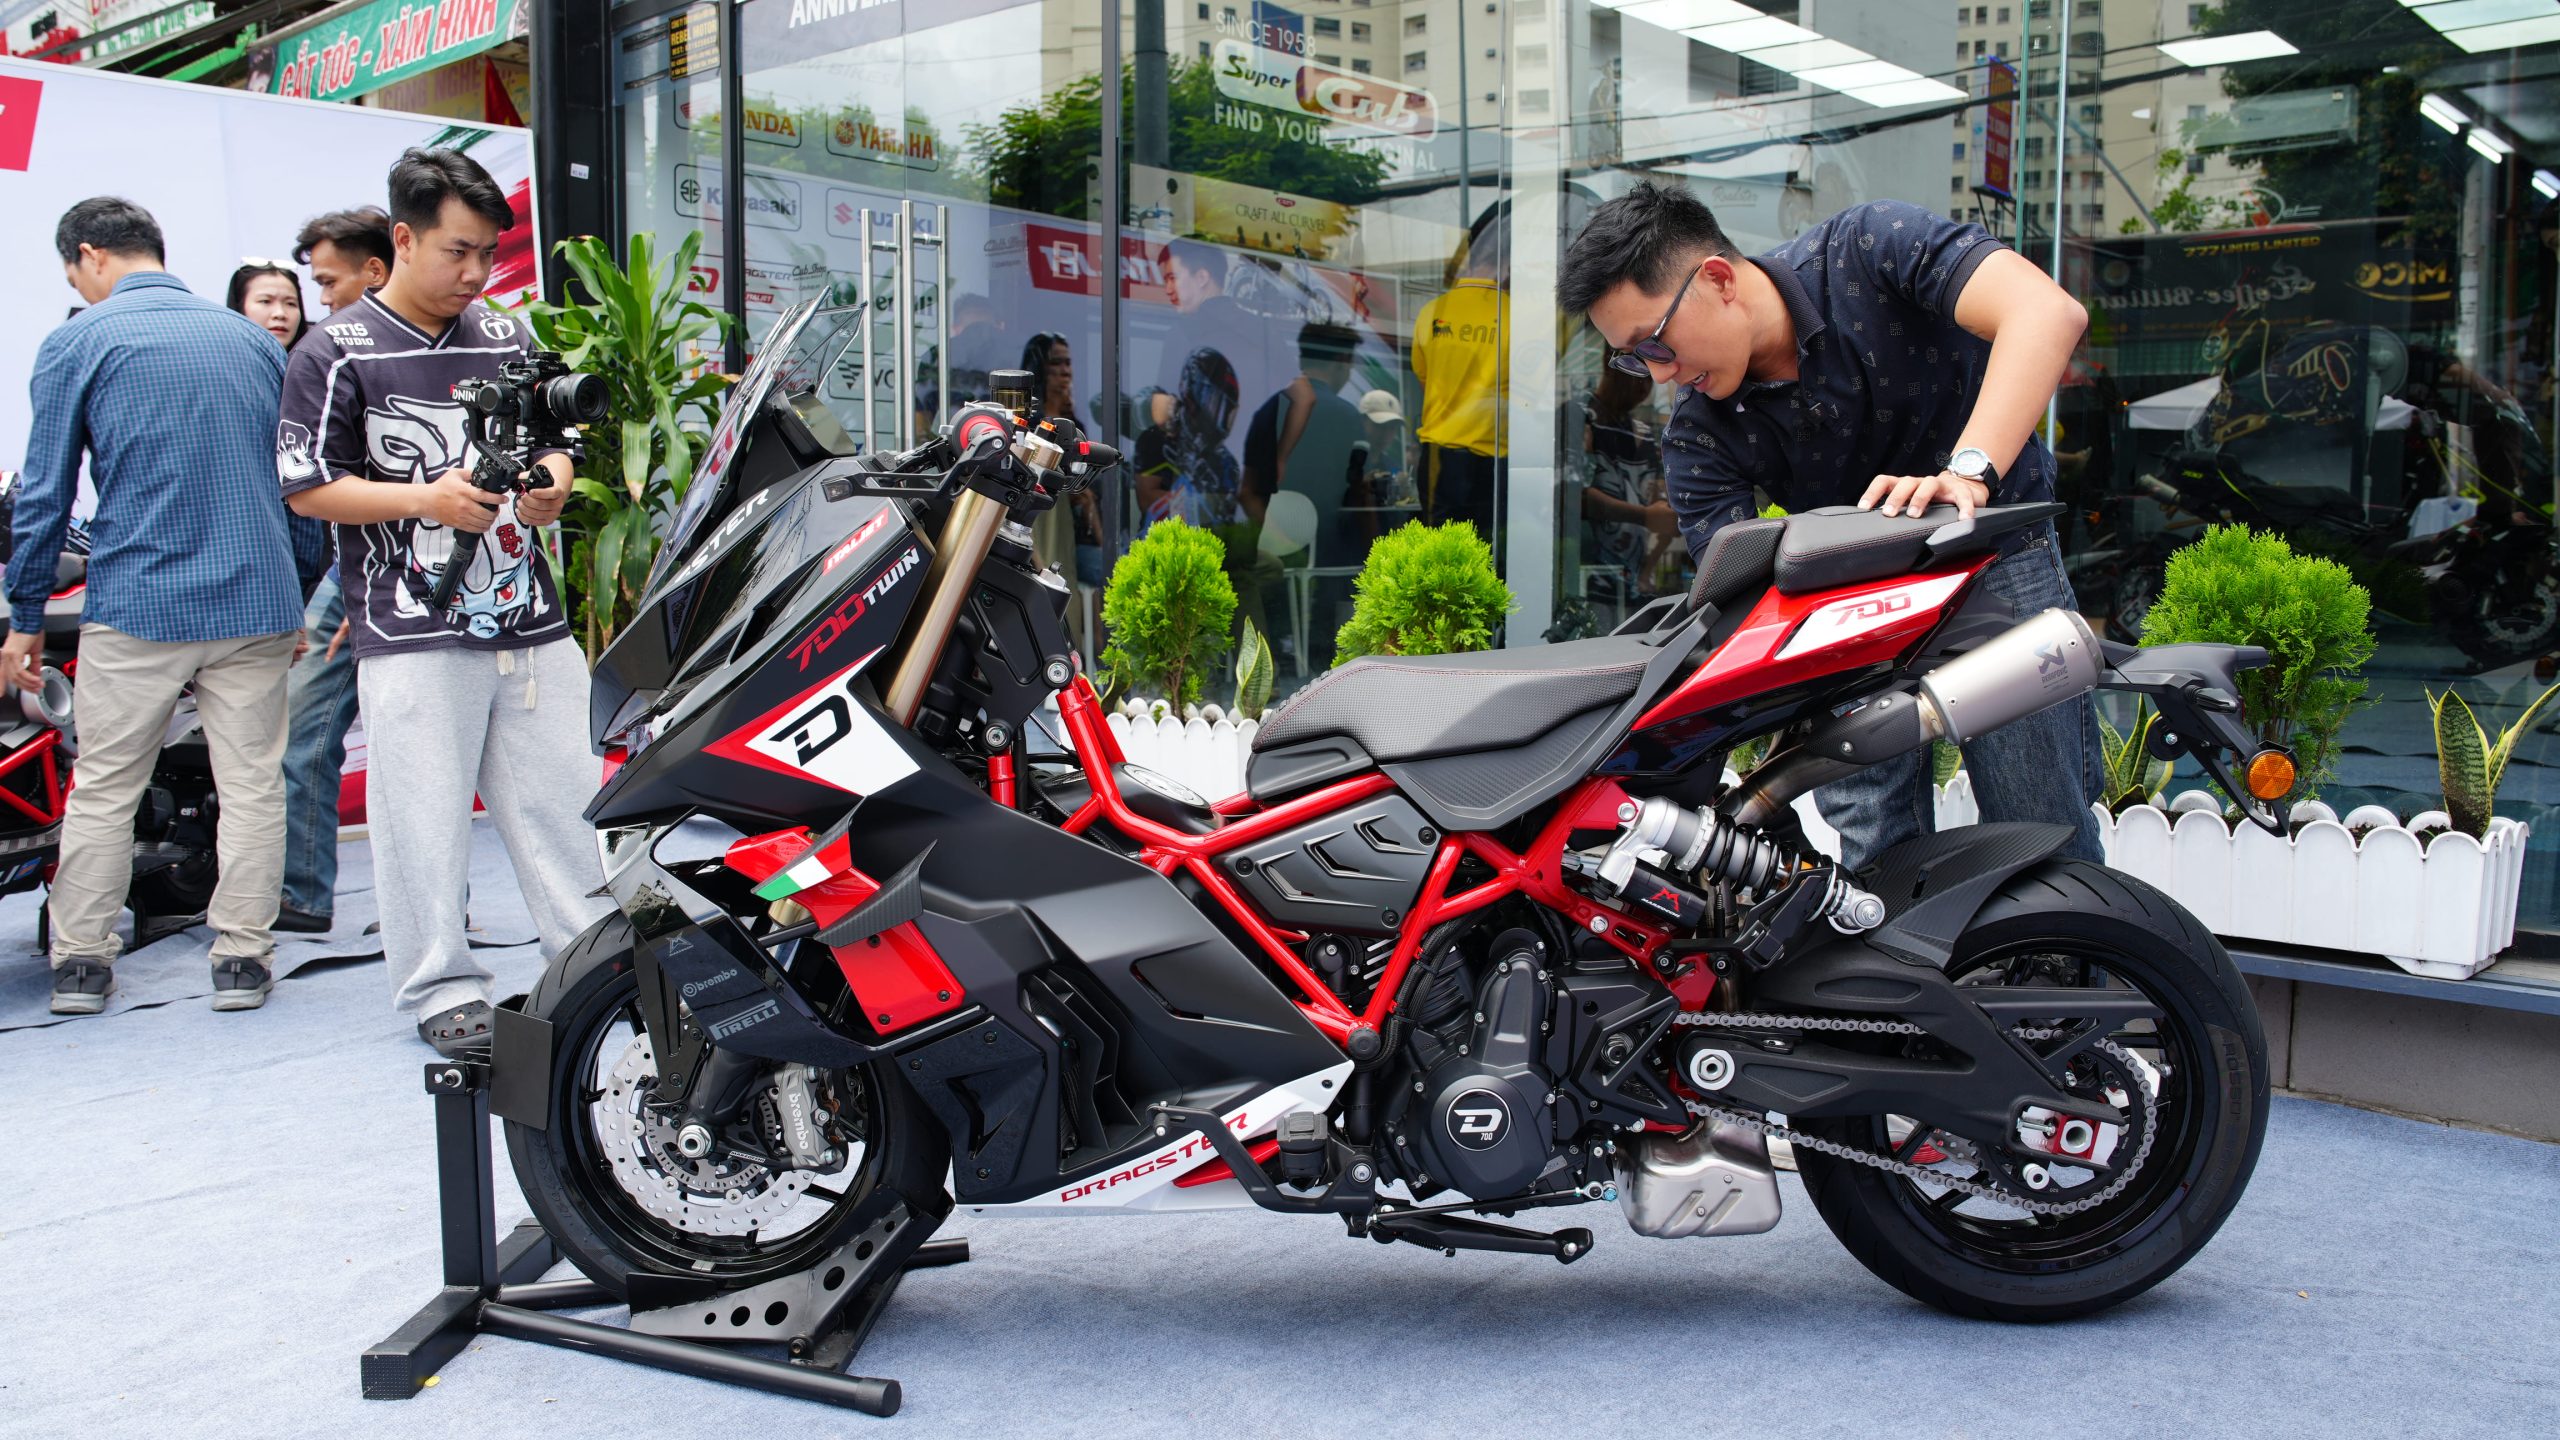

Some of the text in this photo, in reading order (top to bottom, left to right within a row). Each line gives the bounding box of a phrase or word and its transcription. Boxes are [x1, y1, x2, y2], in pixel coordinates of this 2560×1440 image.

[1215, 11, 1317, 57] SINCE 1958
[318, 30, 360, 97] TÓC
[373, 4, 435, 76] XĂM
[1222, 54, 1419, 129] Super Cub
[1215, 103, 1437, 172] FIND YOUR ORIGINAL
[706, 186, 796, 216] Kasaki
[1235, 203, 1268, 222] CRAFT
[857, 210, 932, 233] UZKI
[745, 268, 792, 281] AGSTER
[324, 322, 369, 337] OTIS
[333, 337, 374, 346] STUDIO
[1459, 318, 1498, 345] eni
[452, 388, 477, 402] ONIN
[674, 487, 770, 583] STER
[825, 513, 886, 573] ITALJET
[1829, 592, 1911, 626] 700
[697, 968, 738, 992] brembo
[708, 999, 781, 1040] PIRELLI
[788, 1092, 809, 1150] brembo
[1480, 1131, 1493, 1141] 700
